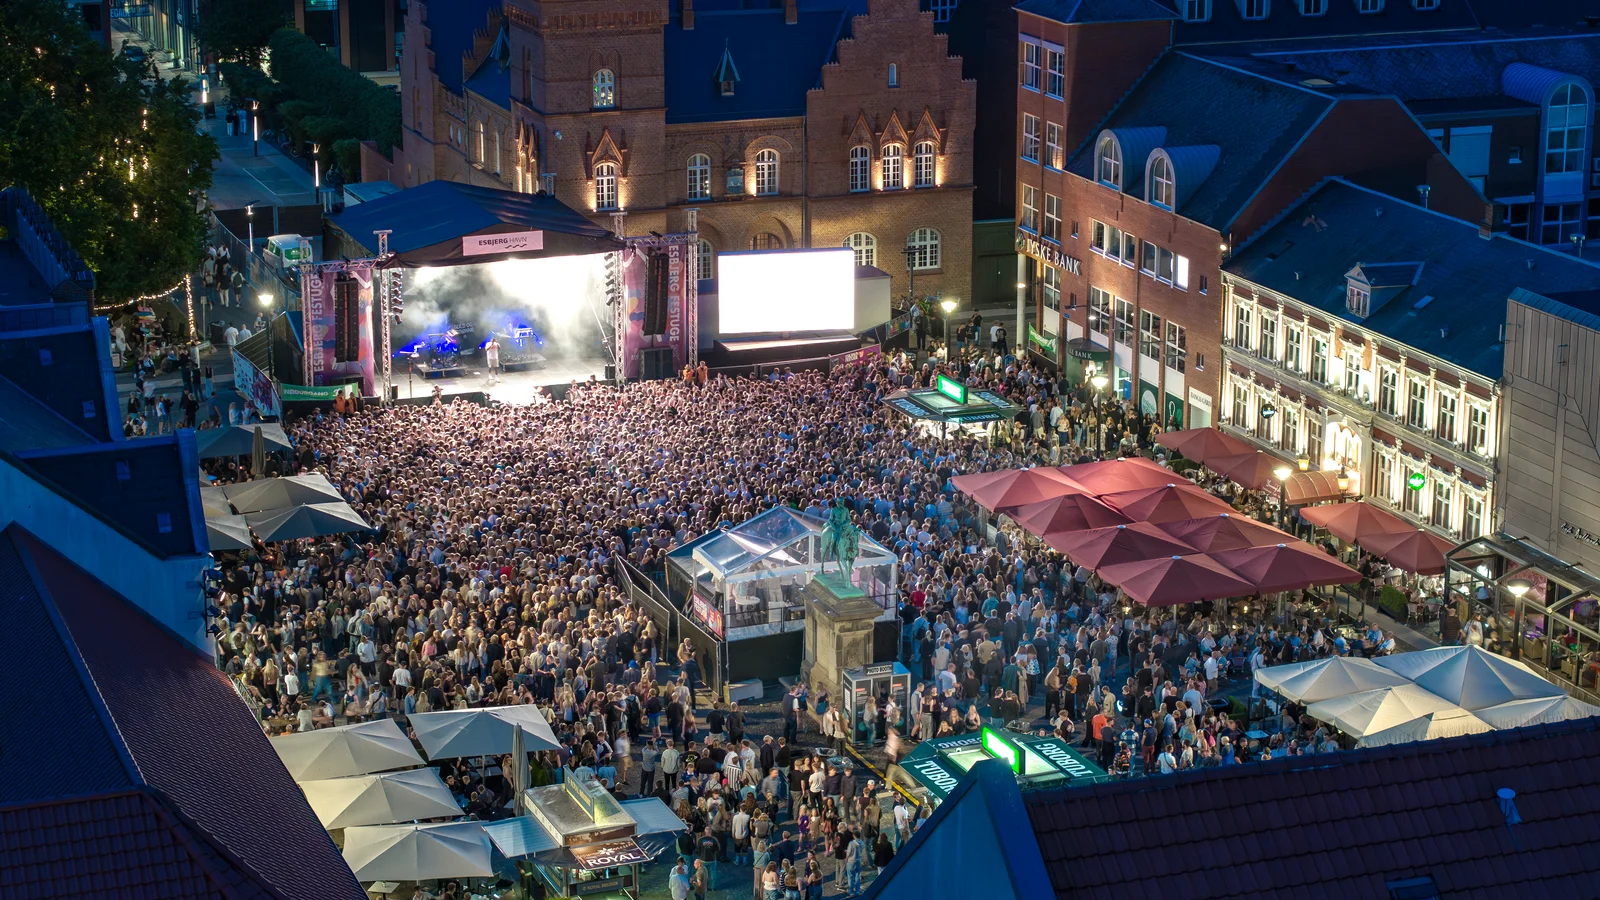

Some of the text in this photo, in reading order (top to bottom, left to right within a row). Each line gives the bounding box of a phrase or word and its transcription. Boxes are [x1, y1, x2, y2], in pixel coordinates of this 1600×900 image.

[478, 238, 509, 246] ESBJERG
[1026, 238, 1080, 276] JYSKE BANK
[668, 245, 680, 292] ESBJERG
[669, 297, 680, 342] FESTUGE
[312, 324, 324, 372] ESBJERG
[1075, 350, 1092, 359] BANK
[1036, 743, 1094, 777] TUBORG
[586, 853, 641, 867] ROYAL
